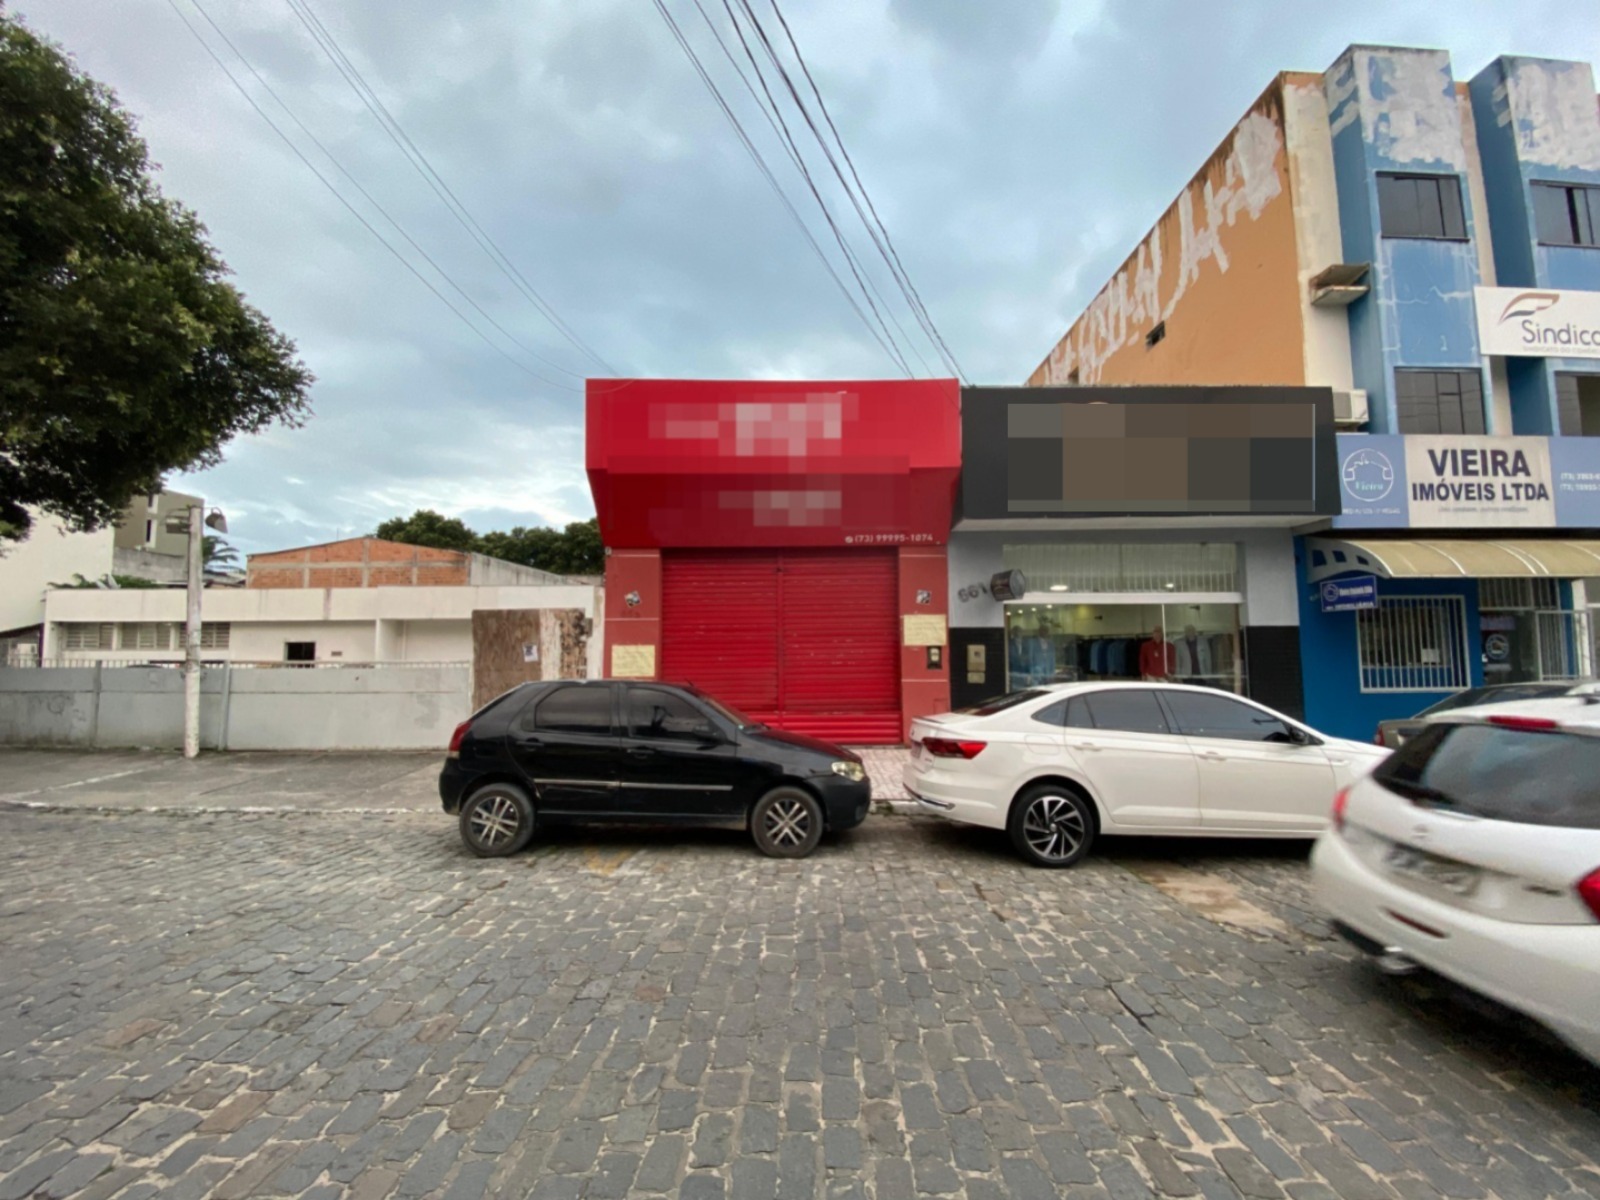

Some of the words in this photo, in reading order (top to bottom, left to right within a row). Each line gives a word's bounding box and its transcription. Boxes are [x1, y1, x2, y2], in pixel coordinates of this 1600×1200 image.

[1427, 449, 1531, 477] VIEIRA
[1412, 478, 1496, 501] IMÓVEIS
[1502, 483, 1550, 501] LTDA
[854, 534, 874, 543] (73)
